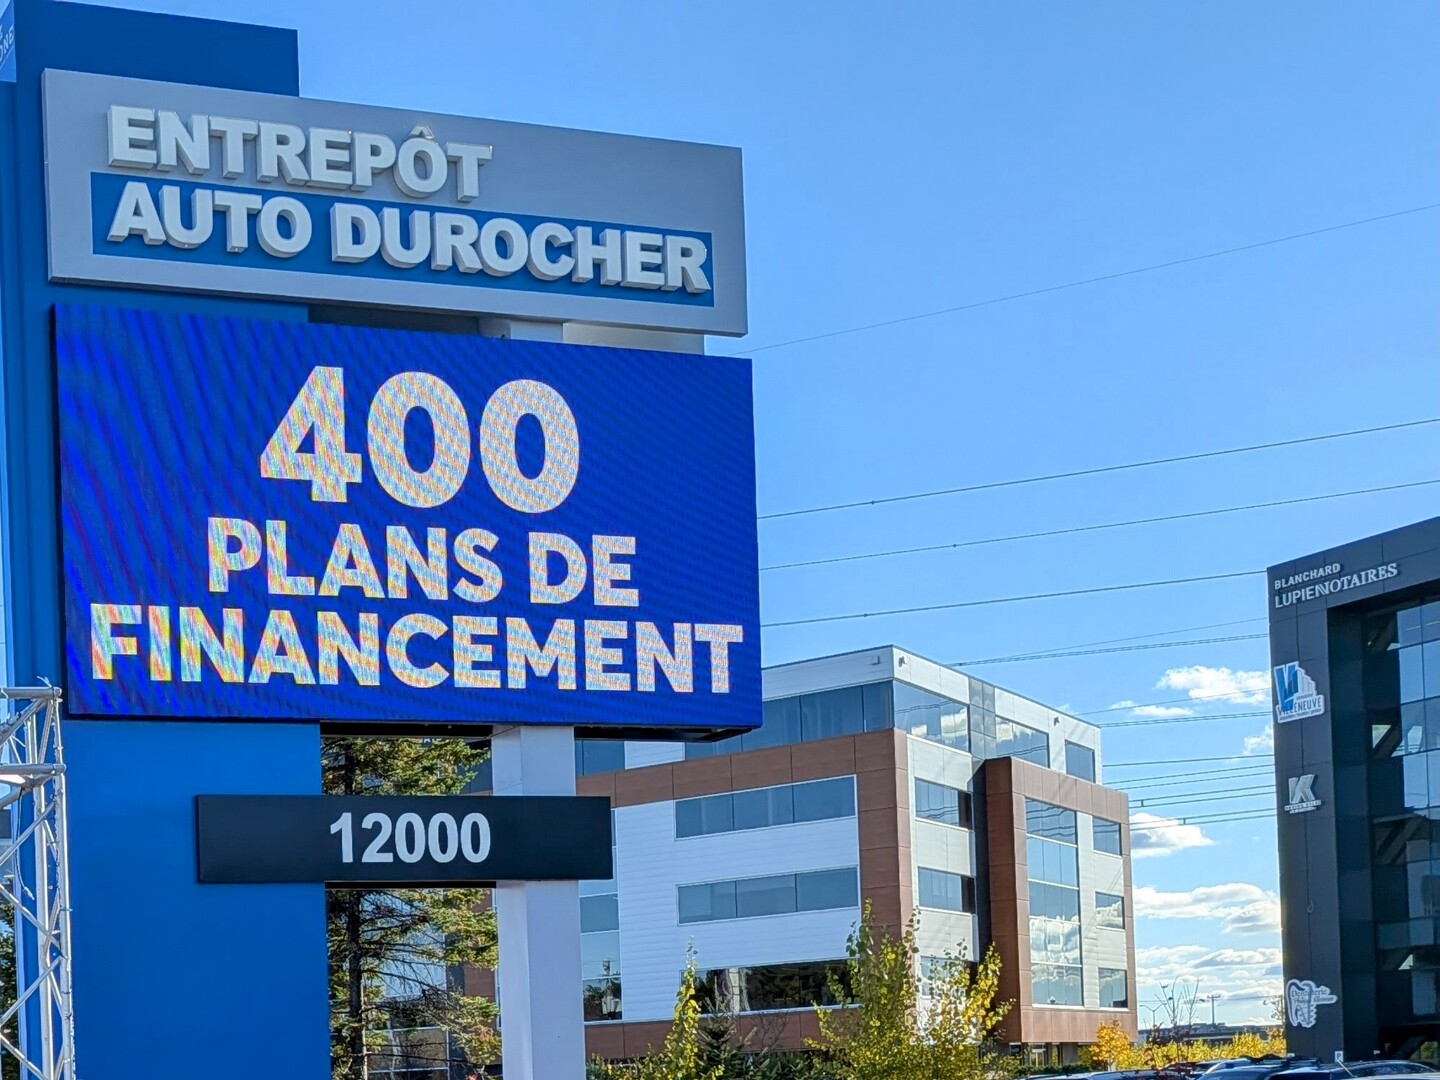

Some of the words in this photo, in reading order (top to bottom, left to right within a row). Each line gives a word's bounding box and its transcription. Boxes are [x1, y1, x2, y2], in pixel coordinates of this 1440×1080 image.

[107, 104, 493, 202] ENTREPÔT
[107, 180, 312, 257] AUTO
[331, 201, 712, 293] DUROCHER
[260, 365, 580, 513] 400
[207, 517, 503, 603] PLANS
[528, 531, 640, 608] DE
[1274, 563, 1341, 590] BLANCHARD
[90, 603, 743, 693] FINANCEMENT
[329, 812, 491, 863] 12000
